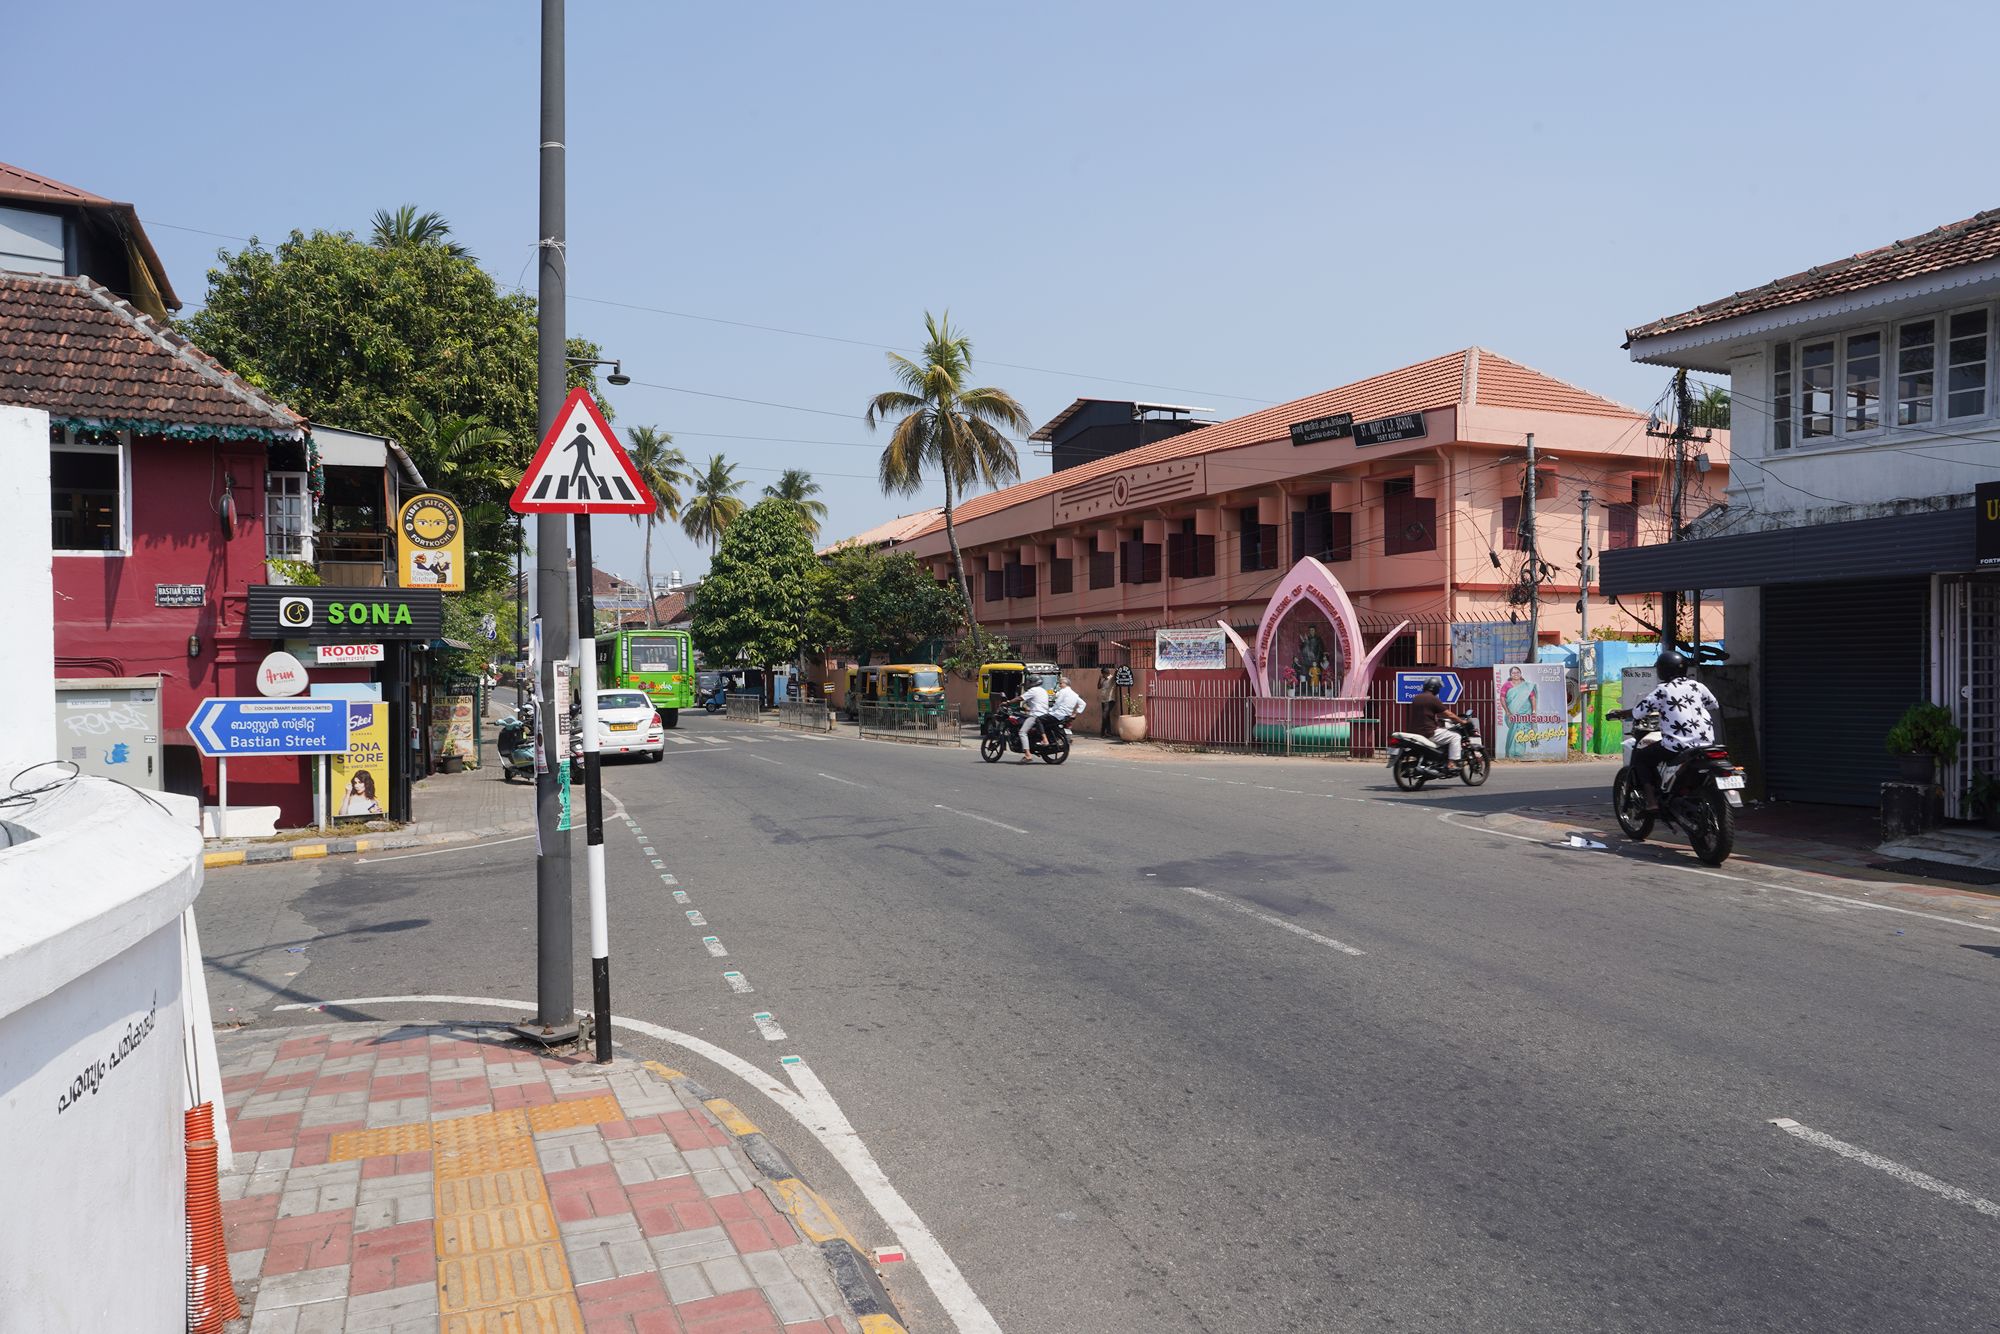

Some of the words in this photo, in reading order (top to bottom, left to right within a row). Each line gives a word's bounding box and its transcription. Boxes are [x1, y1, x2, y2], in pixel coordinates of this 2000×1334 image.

[1395, 416, 1415, 431] SCHOOL
[1377, 434, 1388, 442] FORT
[1388, 431, 1402, 440] KOCHI
[406, 502, 423, 521] TIBET
[424, 500, 455, 521] KITCHEN
[1986, 498, 2000, 521] U
[411, 533, 452, 547] FORTKOCHI
[158, 587, 181, 595] BASTIAN
[182, 587, 202, 595] STREET
[1291, 584, 1303, 597] OF
[328, 602, 413, 625] SONA
[322, 645, 380, 657] ROOMS
[266, 668, 295, 685] Arun
[447, 696, 472, 704] KITCHEN
[230, 736, 280, 748] Bastian
[285, 735, 327, 747] Street
[350, 742, 381, 752] ONA
[337, 752, 384, 764] STORE
